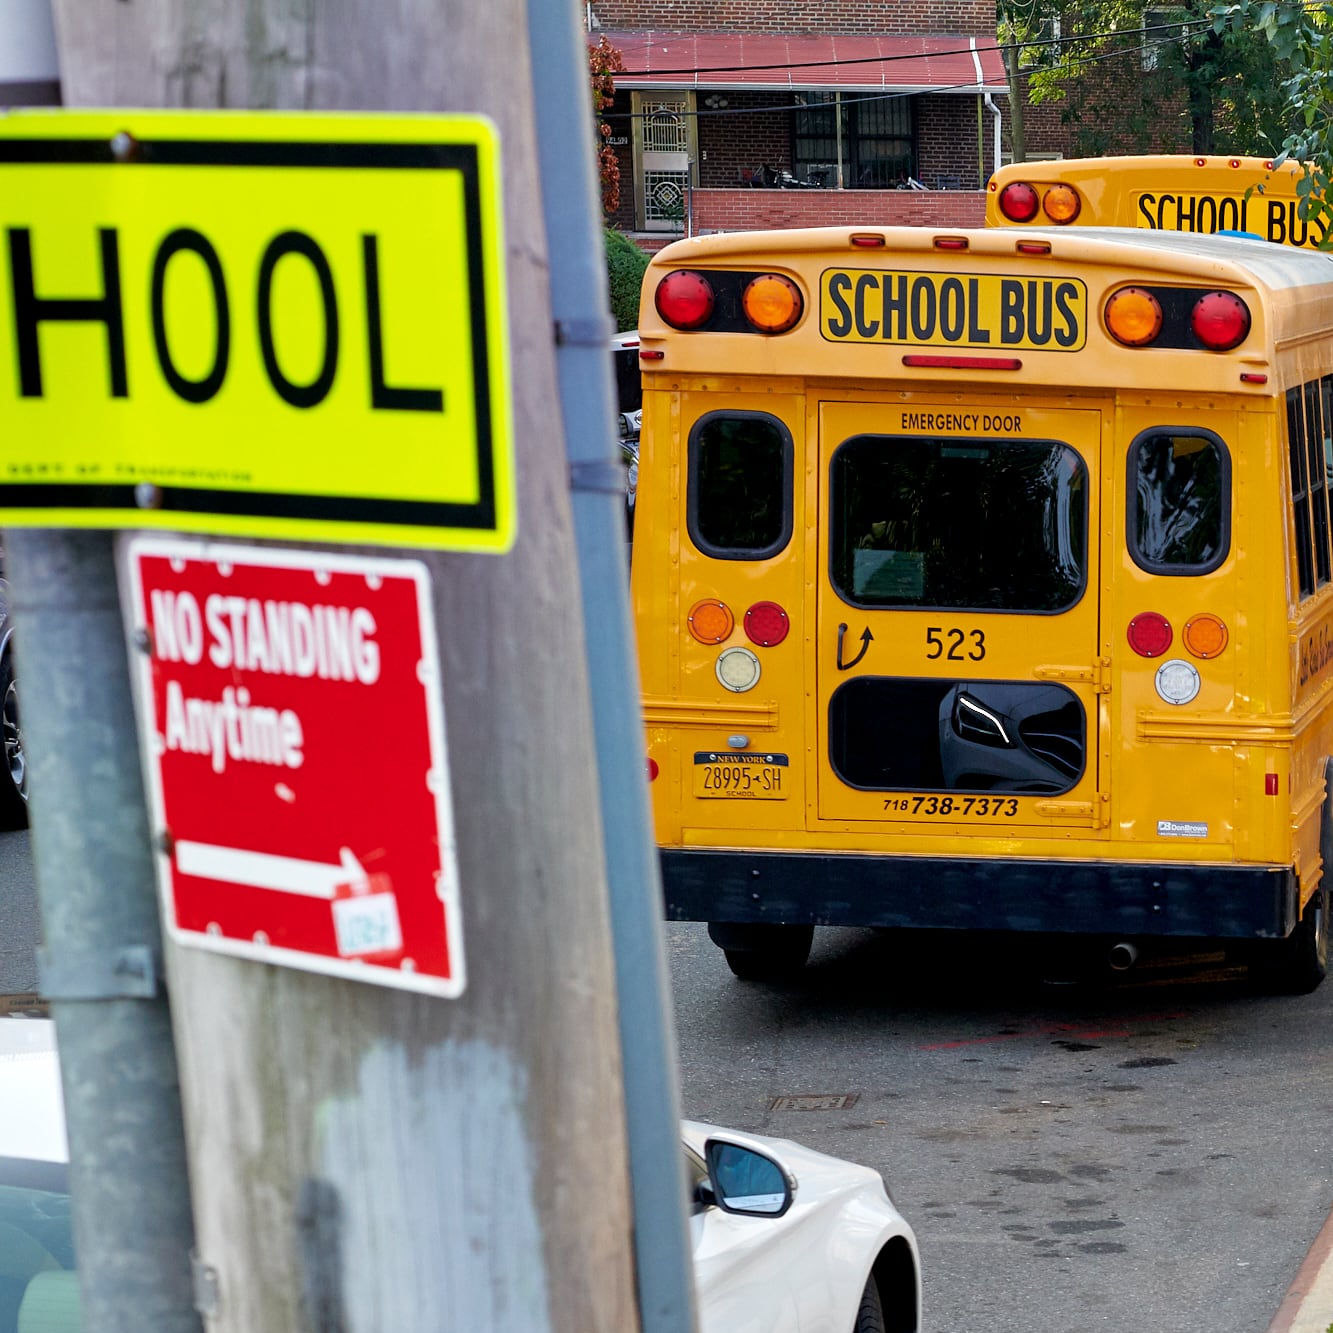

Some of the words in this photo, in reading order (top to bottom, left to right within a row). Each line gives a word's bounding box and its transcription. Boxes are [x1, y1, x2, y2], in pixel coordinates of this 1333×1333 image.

[6, 227, 445, 413] HOOL
[828, 272, 990, 342] SCHOOL
[1000, 279, 1079, 347] BUS
[901, 413, 980, 431] EMERGENCY
[983, 415, 1021, 432] DOOR
[150, 590, 203, 664] NO
[206, 591, 380, 686] STANDING
[926, 627, 986, 661] 523
[164, 680, 304, 774] Anytime
[717, 755, 740, 763] NEW
[741, 756, 766, 764] YORK
[883, 799, 909, 811] 718
[911, 796, 1019, 816] 738-7373
